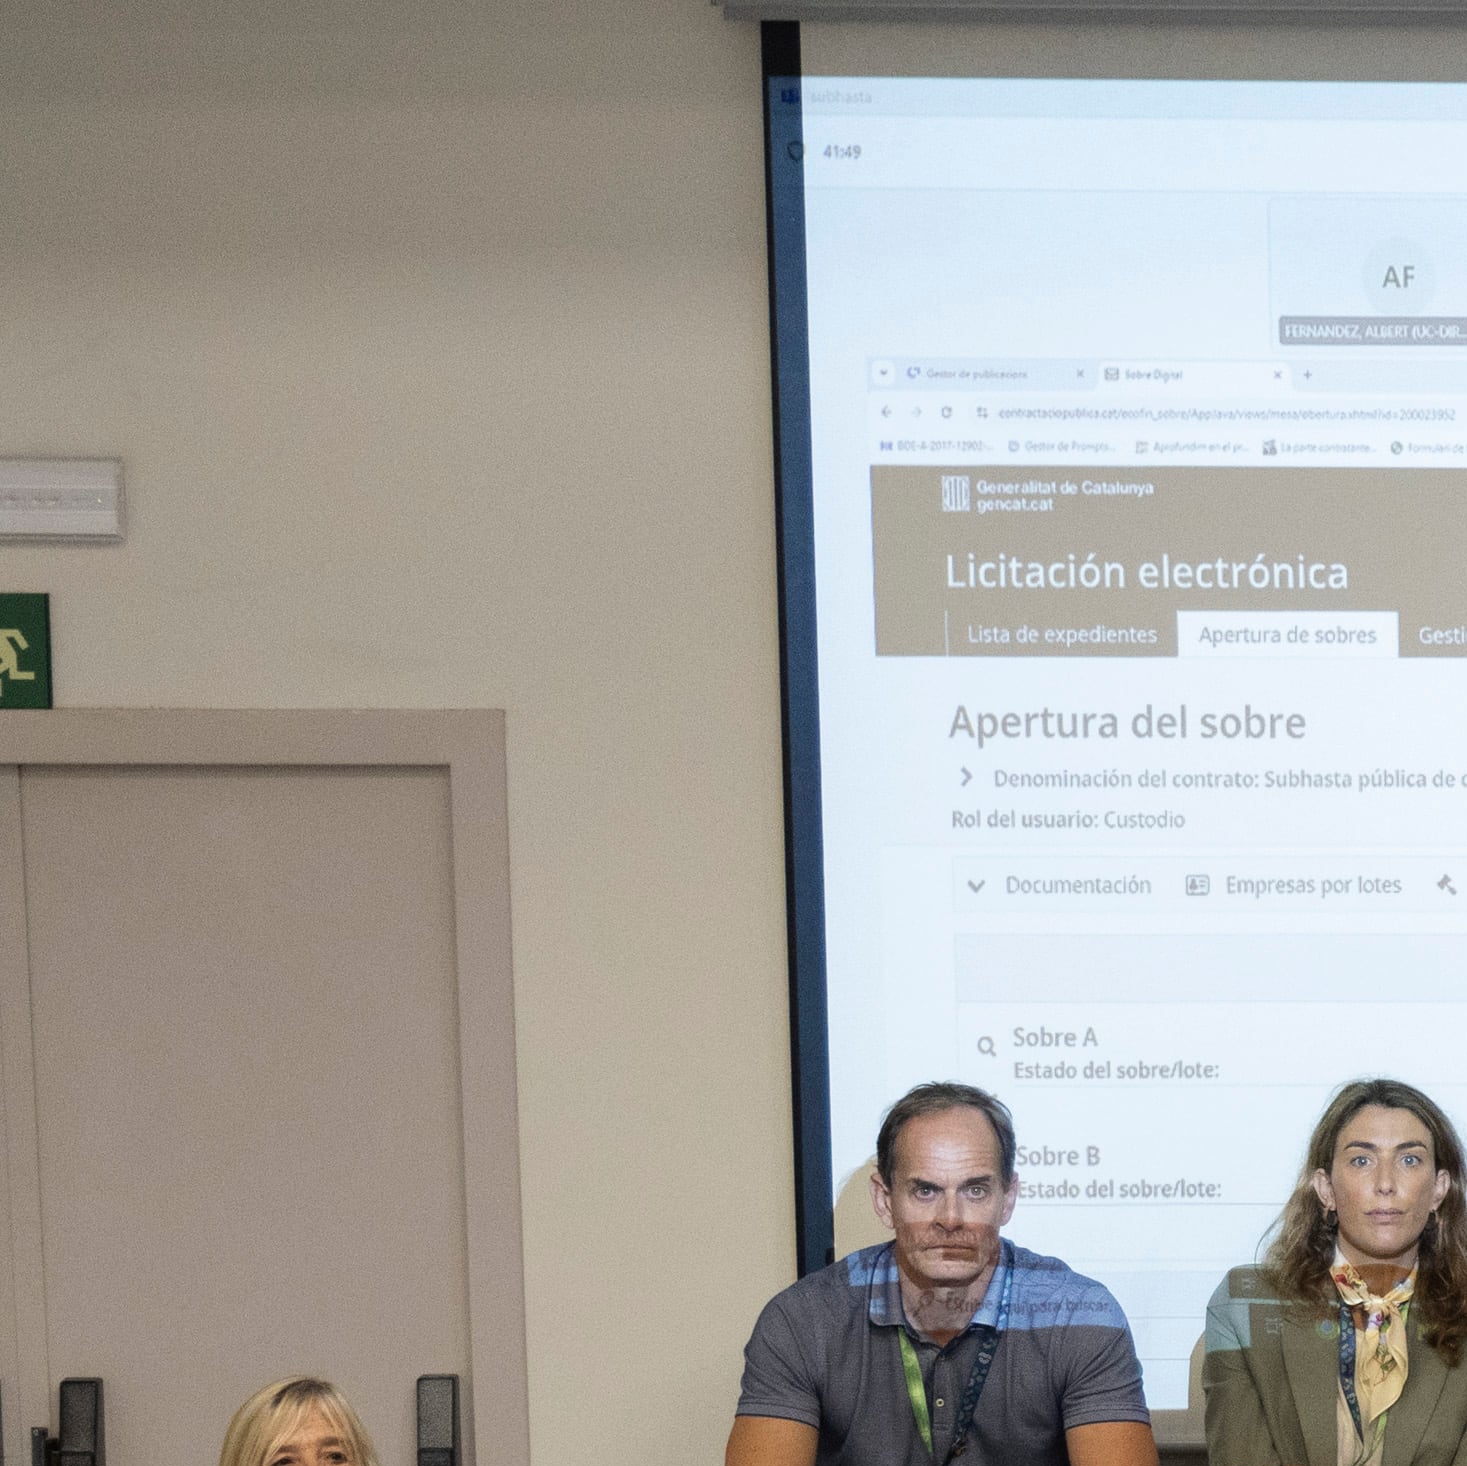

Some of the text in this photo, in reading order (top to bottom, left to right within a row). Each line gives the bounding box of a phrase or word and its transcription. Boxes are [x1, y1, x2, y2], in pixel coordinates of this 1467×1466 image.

[822, 143, 862, 159] 41:49
[1381, 264, 1416, 289] AF
[1365, 324, 1410, 339] ALBERT
[977, 480, 1155, 498] Generalitat de Catalunya
[977, 496, 1055, 513] gencat.cat
[946, 552, 1349, 590] Licitación electrónica
[968, 626, 1158, 651] Lista de expedientes
[1199, 627, 1378, 651] Apertura de sobres
[949, 703, 1306, 749] Apertura del sobre
[994, 769, 1133, 789] Denominación
[1138, 769, 1167, 788] del
[1172, 771, 1260, 788] contrato:
[1264, 769, 1353, 789] Subhasta
[1357, 769, 1427, 793] pública
[1431, 769, 1456, 788] de
[951, 810, 1186, 830] Rol del usuario: Custodio
[1006, 874, 1152, 895] Documentación
[1225, 875, 1403, 899] Empresas por lotes
[1013, 1027, 1098, 1048] Sobre A
[1013, 1060, 1220, 1081] Estado del sobre/lote:
[1017, 1146, 1100, 1166] Sobre B
[1084, 1180, 1114, 1199] del
[1118, 1179, 1222, 1200] sobre/lote:
